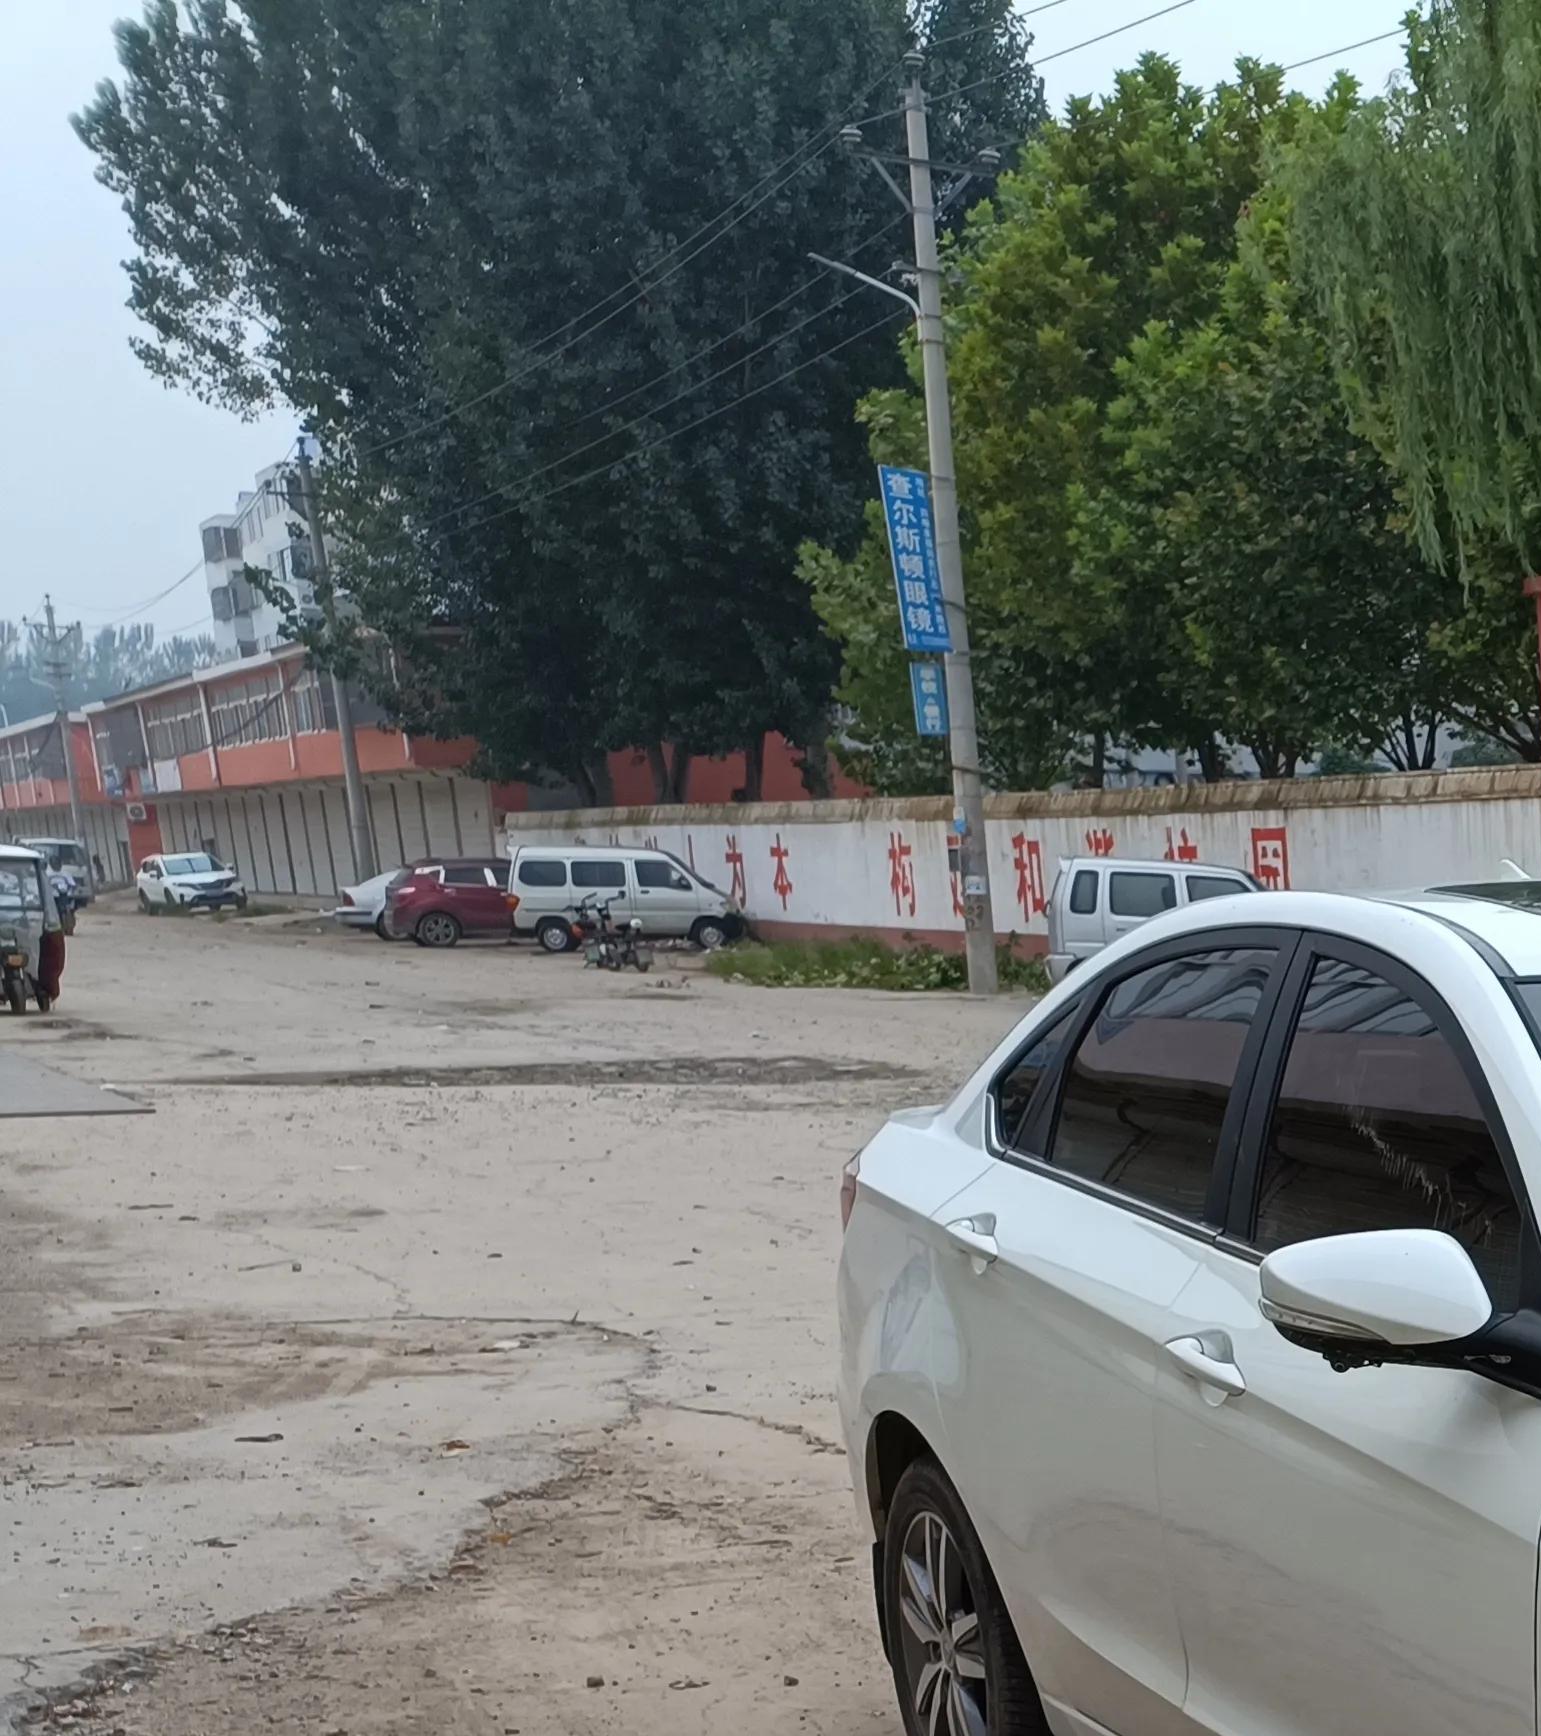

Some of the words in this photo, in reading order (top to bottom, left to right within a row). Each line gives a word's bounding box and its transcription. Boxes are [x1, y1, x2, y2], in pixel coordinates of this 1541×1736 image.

[887, 473, 933, 632] 查尔斯顿眼镜
